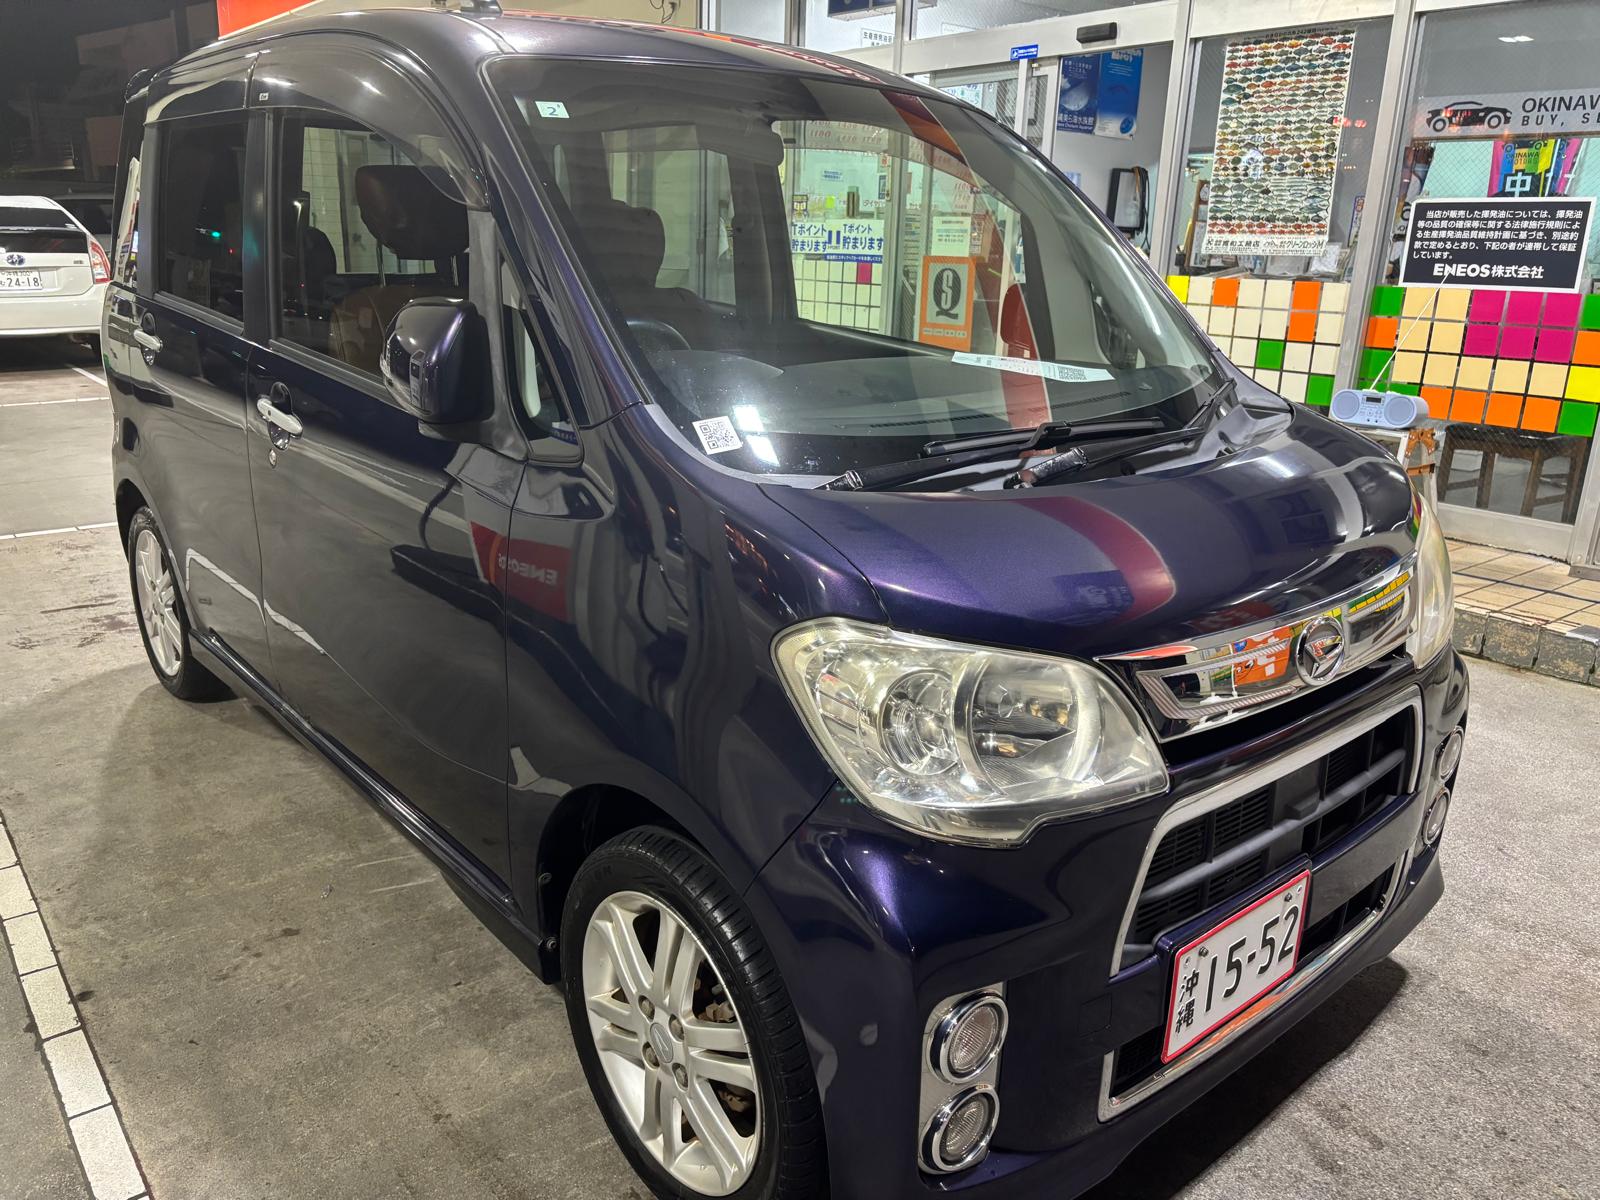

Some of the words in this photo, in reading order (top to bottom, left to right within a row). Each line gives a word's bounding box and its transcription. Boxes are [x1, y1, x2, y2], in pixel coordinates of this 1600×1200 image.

[547, 106, 558, 116] 2
[1521, 113, 1565, 127] BUY,
[1505, 171, 1532, 198] 中
[842, 235, 884, 252] 貯まります
[1412, 250, 1453, 260] しています。
[6, 277, 39, 288] 24-18
[1205, 904, 1300, 1013] 15-52
[1174, 966, 1200, 1035] 沖縄
